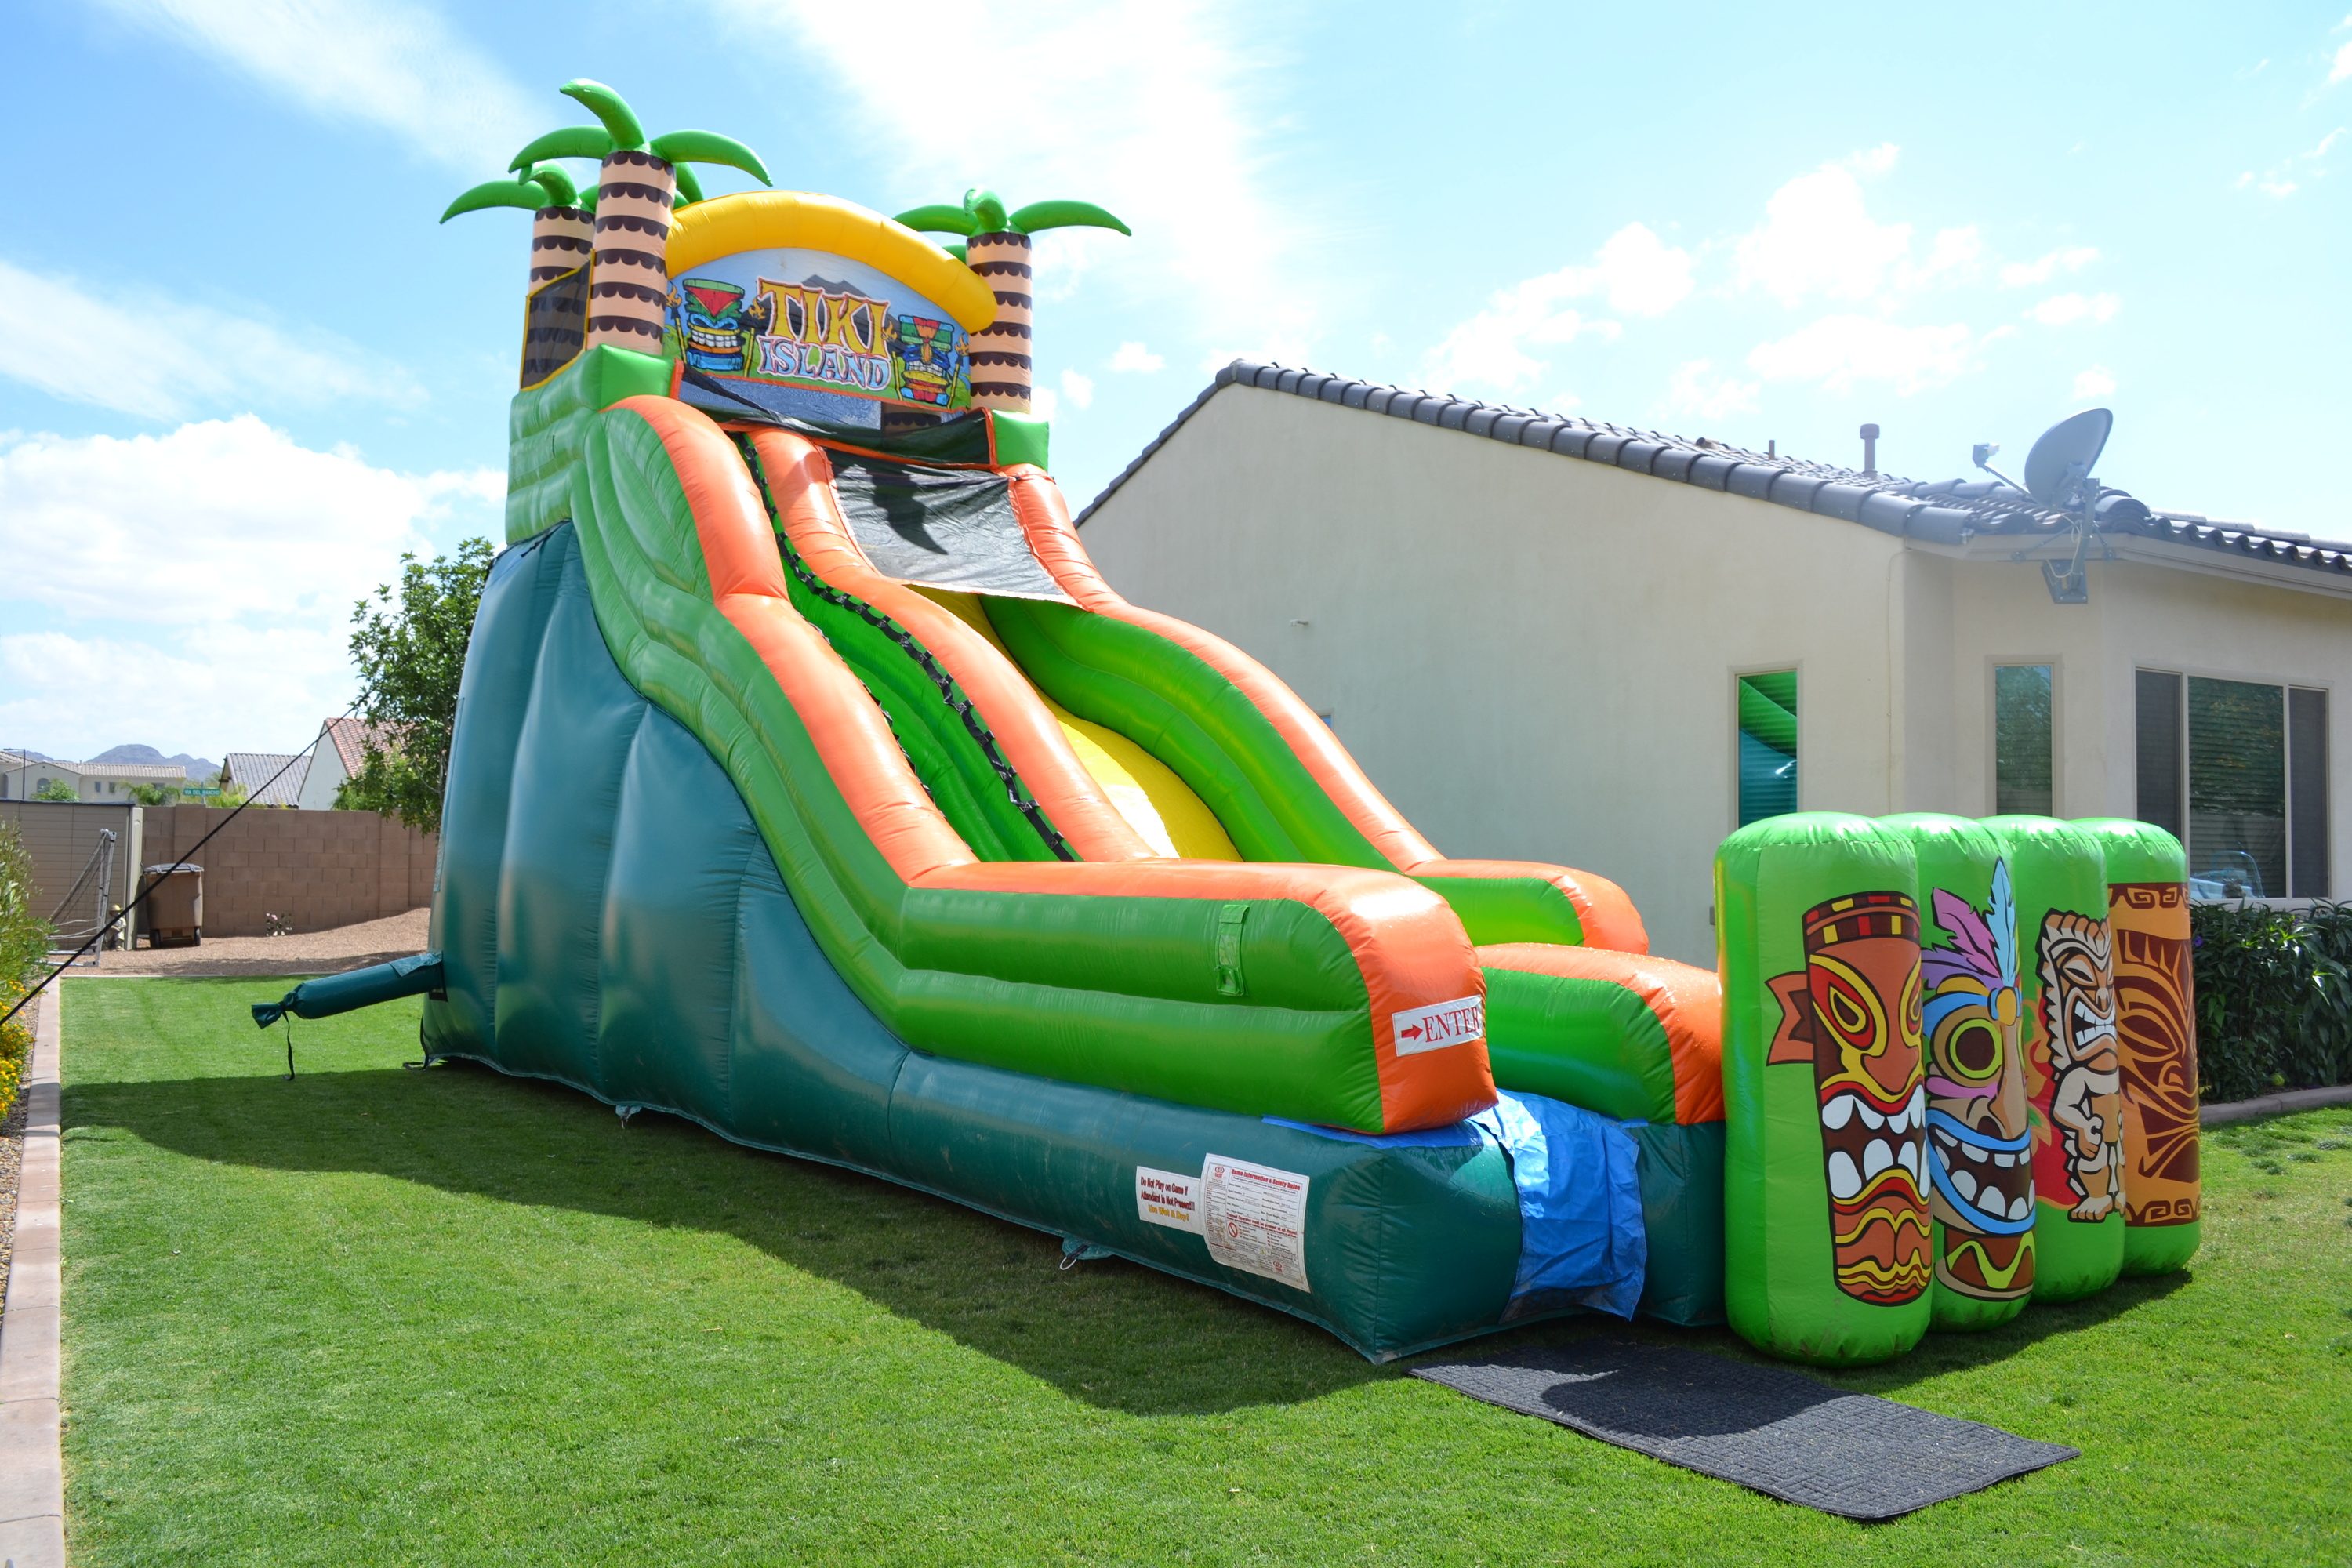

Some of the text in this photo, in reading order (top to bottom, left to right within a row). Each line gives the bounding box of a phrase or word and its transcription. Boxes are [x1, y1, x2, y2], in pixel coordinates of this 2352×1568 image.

[757, 277, 889, 357] TIKI
[757, 336, 891, 390] ISLAND
[1422, 1006, 1480, 1043] ENTER
[1140, 1176, 1147, 1186] Do
[1155, 1179, 1164, 1192] Play
[1165, 1183, 1171, 1192] on
[1171, 1182, 1184, 1195] Game
[1243, 1171, 1269, 1182] Information
[1272, 1178, 1287, 1188] Safety
[1140, 1190, 1160, 1203] Attendant
